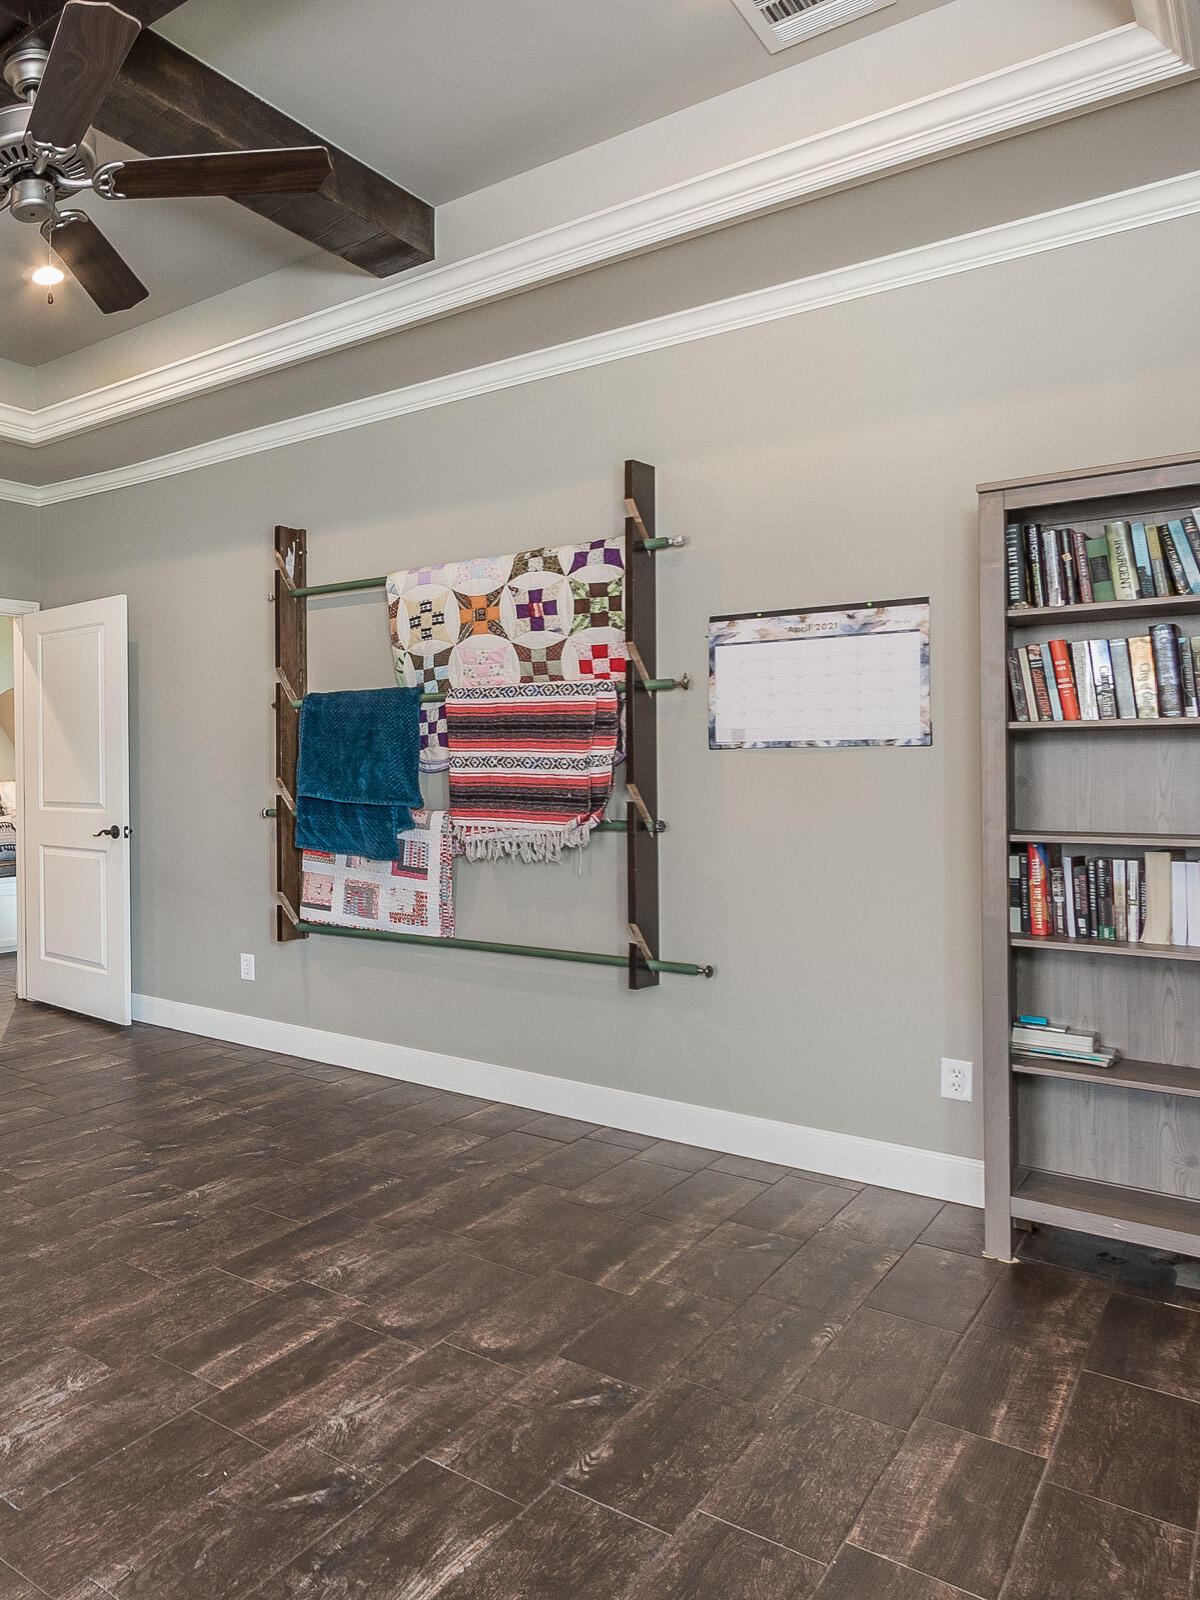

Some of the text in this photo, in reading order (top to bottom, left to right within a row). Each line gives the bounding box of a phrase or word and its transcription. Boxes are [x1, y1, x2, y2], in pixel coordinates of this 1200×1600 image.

[1008, 547, 1018, 564] KATE
[1114, 539, 1131, 590] INSURGENT
[1009, 566, 1020, 600] ATKINSON
[787, 622, 838, 634] April 2021
[1097, 665, 1110, 683] City
[1136, 662, 1151, 682] City
[1031, 669, 1052, 716] CORRECTIONS
[1101, 691, 1113, 716] Ashes
